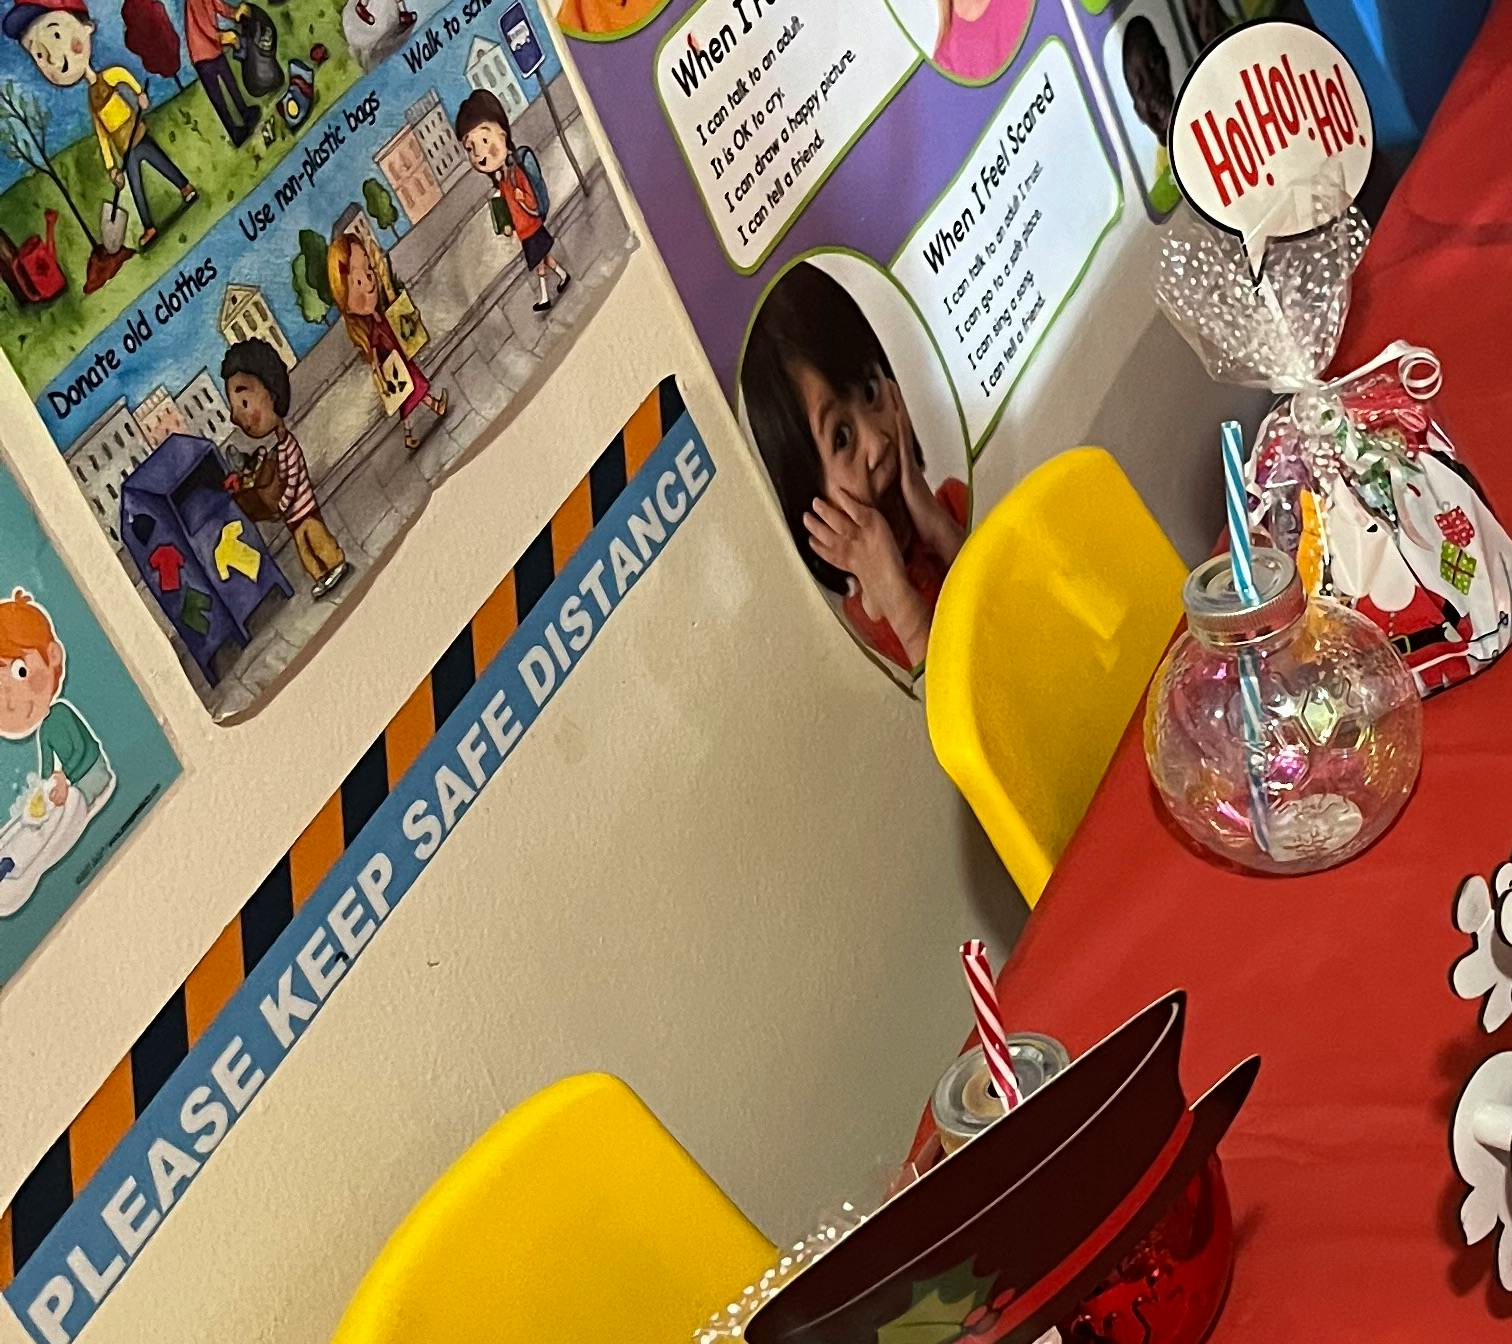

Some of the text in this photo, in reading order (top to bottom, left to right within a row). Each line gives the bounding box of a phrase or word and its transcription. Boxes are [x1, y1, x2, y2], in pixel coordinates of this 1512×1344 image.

[402, 28, 444, 74] Walk
[443, 16, 460, 40] to
[671, 24, 737, 97] When
[696, 124, 708, 146] I
[707, 105, 729, 135] can
[727, 78, 750, 110] talk
[747, 67, 761, 86] to
[761, 49, 777, 71] an
[239, 89, 380, 241] Use non-plastic bags
[710, 157, 725, 180] It
[722, 147, 735, 165] is
[733, 119, 753, 151] OK
[751, 110, 765, 131] to
[724, 191, 735, 213] I
[735, 172, 756, 202] can
[755, 138, 780, 176] draw
[780, 127, 789, 143] a
[786, 90, 821, 133] happy
[922, 71, 1054, 275] When I Feel Scared
[737, 225, 748, 246] I
[748, 205, 769, 234] can
[766, 178, 784, 208] tell
[784, 172, 793, 187] a
[943, 296, 953, 316] I
[952, 278, 970, 305] can
[968, 253, 986, 282] talk
[984, 241, 997, 260] to
[996, 225, 1006, 244] an
[1017, 183, 1027, 201] I
[47, 257, 217, 419] Donate old clothes
[955, 263, 1011, 344] I can go to a
[967, 352, 977, 371] I
[976, 333, 994, 361] can
[992, 307, 1012, 337] sing
[1010, 297, 1018, 312] a
[980, 380, 990, 398] I
[989, 361, 1006, 388] can
[1003, 335, 1018, 364] tell
[1016, 330, 1024, 345] a
[258, 852, 395, 1049] KEEP
[402, 689, 524, 861] SAFE
[517, 438, 710, 708] DISTANCE
